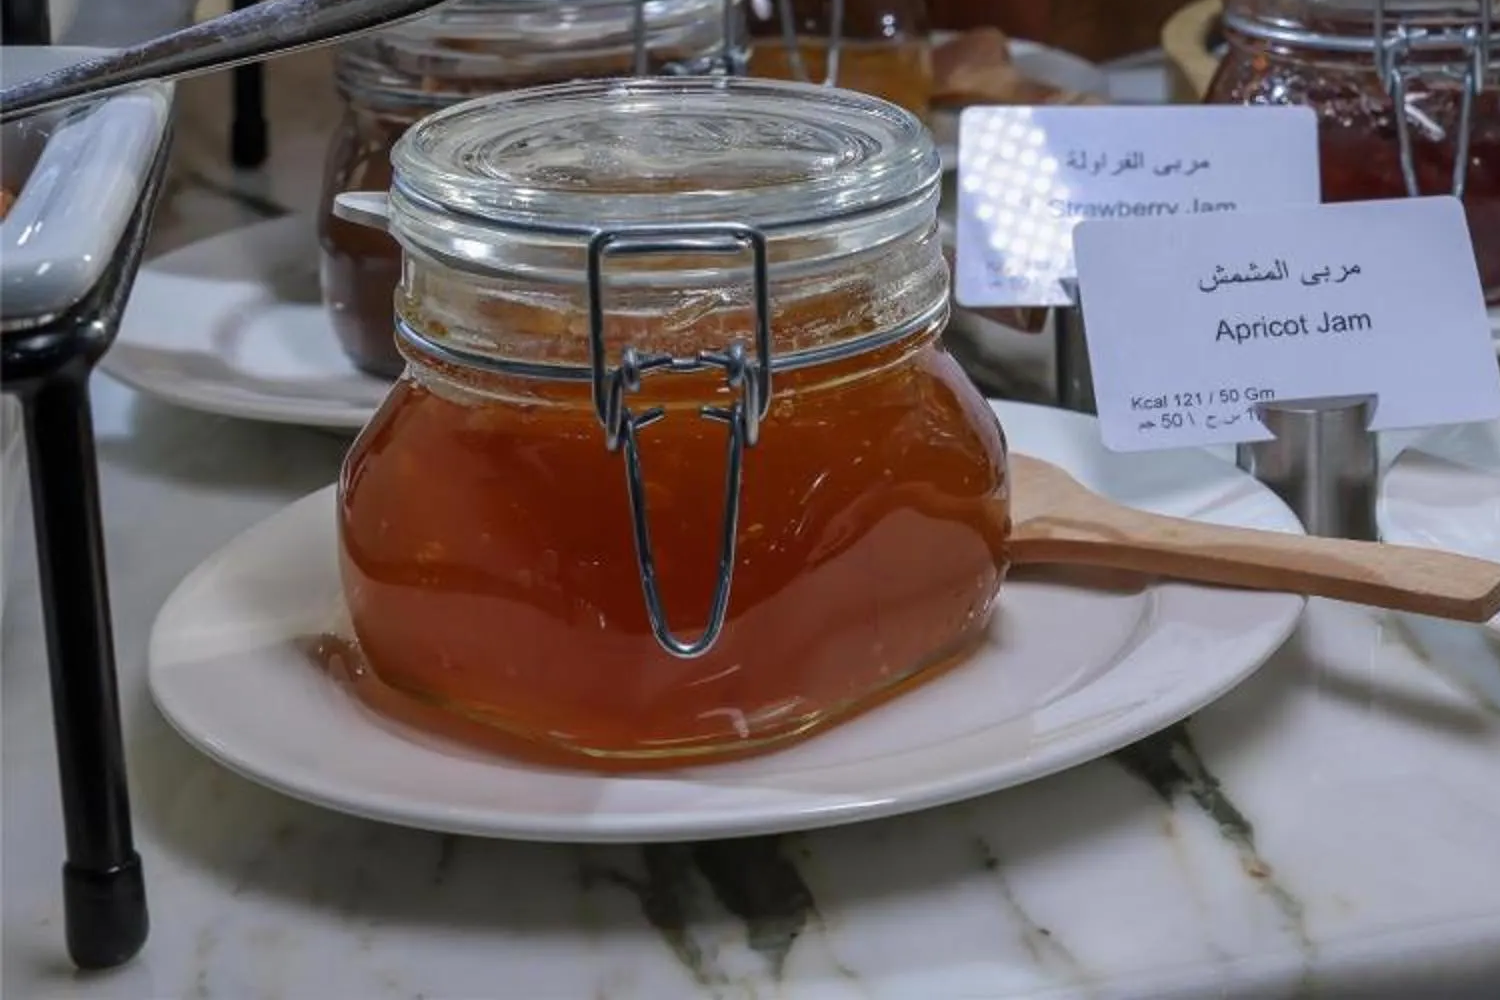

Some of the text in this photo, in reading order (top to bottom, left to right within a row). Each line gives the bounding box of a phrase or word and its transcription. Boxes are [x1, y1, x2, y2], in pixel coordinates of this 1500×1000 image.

[1154, 159, 1211, 177] مربى
[1198, 259, 1362, 293] مربى المشمش
[1215, 311, 1372, 345] Apricot Jam
[1131, 394, 1168, 410] Kcal
[1173, 392, 1203, 407] 121
[1219, 389, 1239, 404] 50
[1244, 387, 1275, 401] Gm
[1161, 413, 1183, 429] 50
